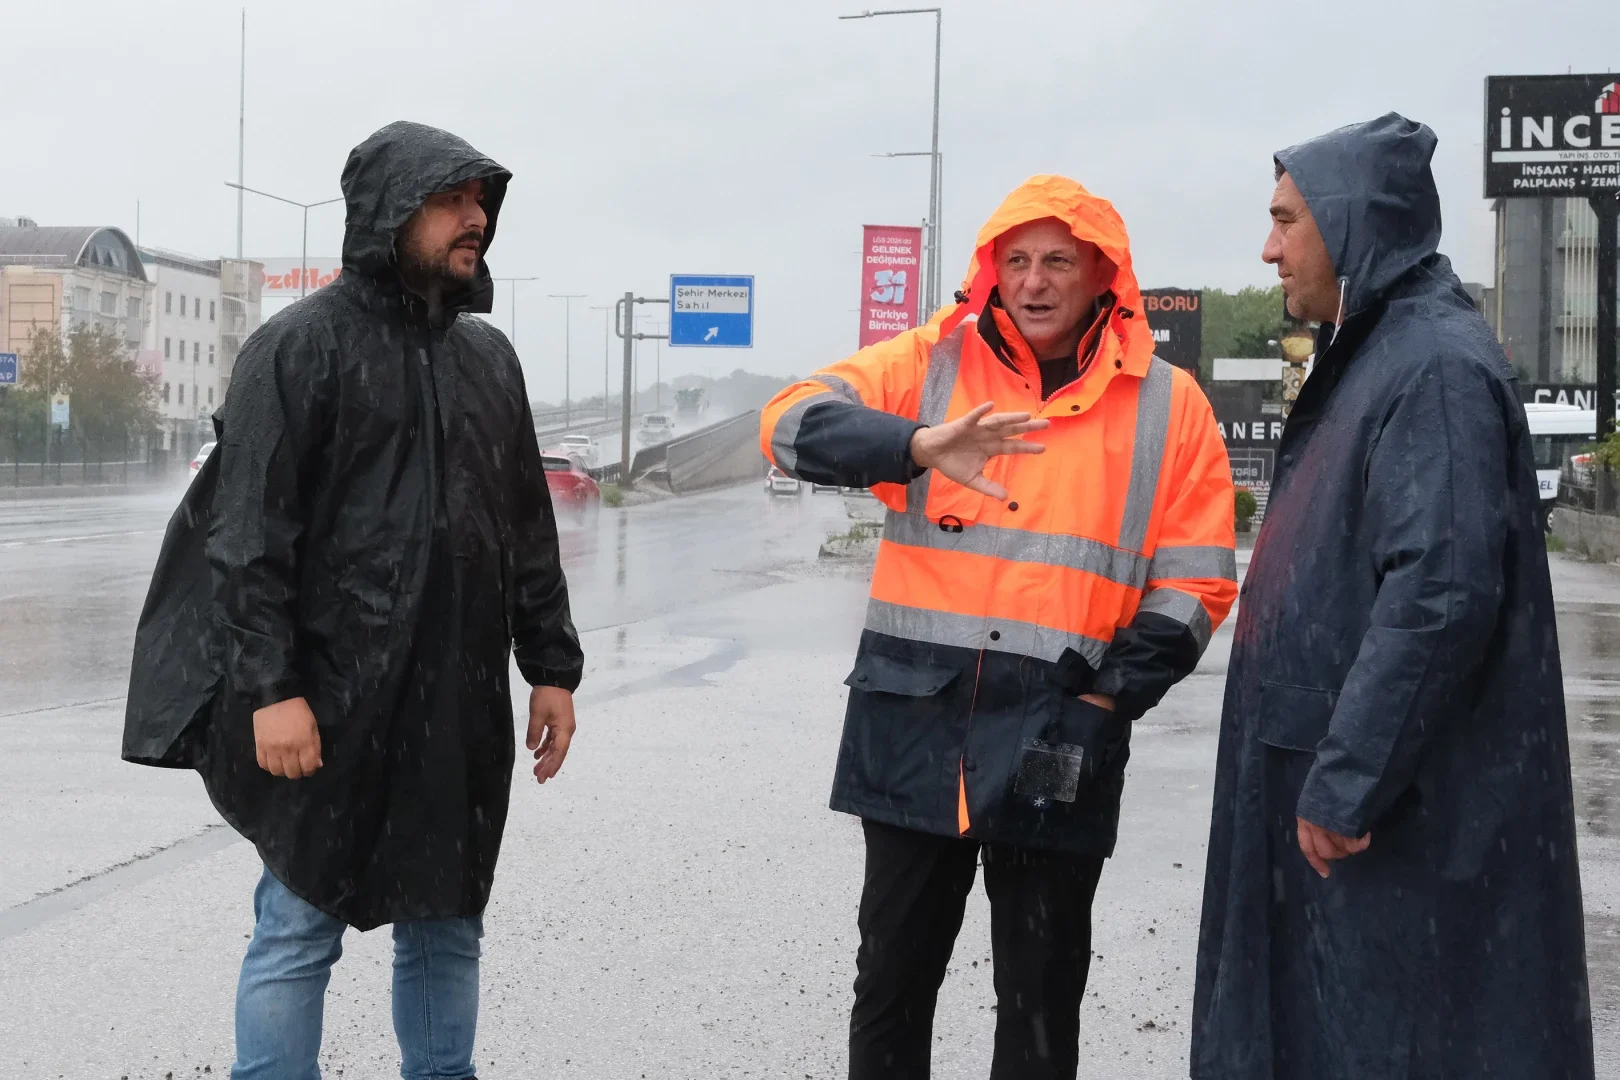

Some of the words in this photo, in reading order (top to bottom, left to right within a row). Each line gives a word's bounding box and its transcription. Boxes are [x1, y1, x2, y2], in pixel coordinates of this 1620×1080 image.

[1501, 107, 1620, 148] İNCE
[1522, 163, 1568, 177] İNŞAAT
[1513, 178, 1576, 189] PALPLANŞ
[872, 245, 912, 254] GELENEK
[677, 288, 704, 297] Şehir
[707, 289, 747, 298] Merkezi
[677, 301, 709, 309] Sahil
[869, 309, 908, 322] Türkiye
[868, 321, 909, 331] Birincisi
